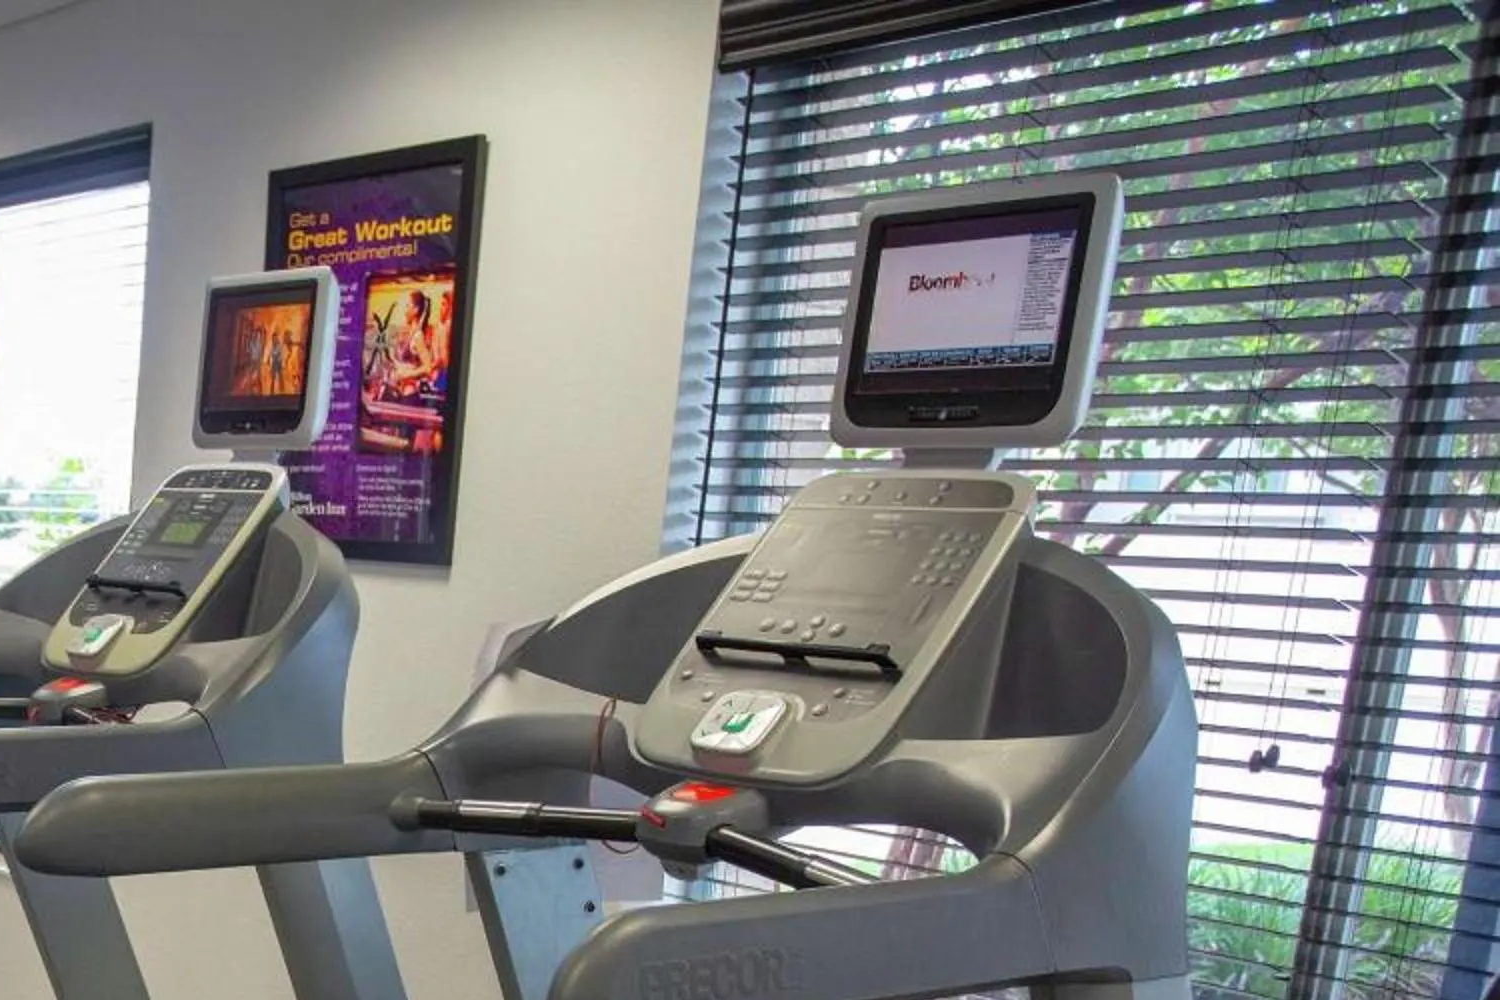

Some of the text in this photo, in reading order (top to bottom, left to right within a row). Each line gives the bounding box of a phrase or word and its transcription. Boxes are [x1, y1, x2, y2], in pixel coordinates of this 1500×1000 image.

[288, 213, 454, 252] Great Workout
[290, 211, 330, 228] Get a
[318, 239, 418, 266] compliments!
